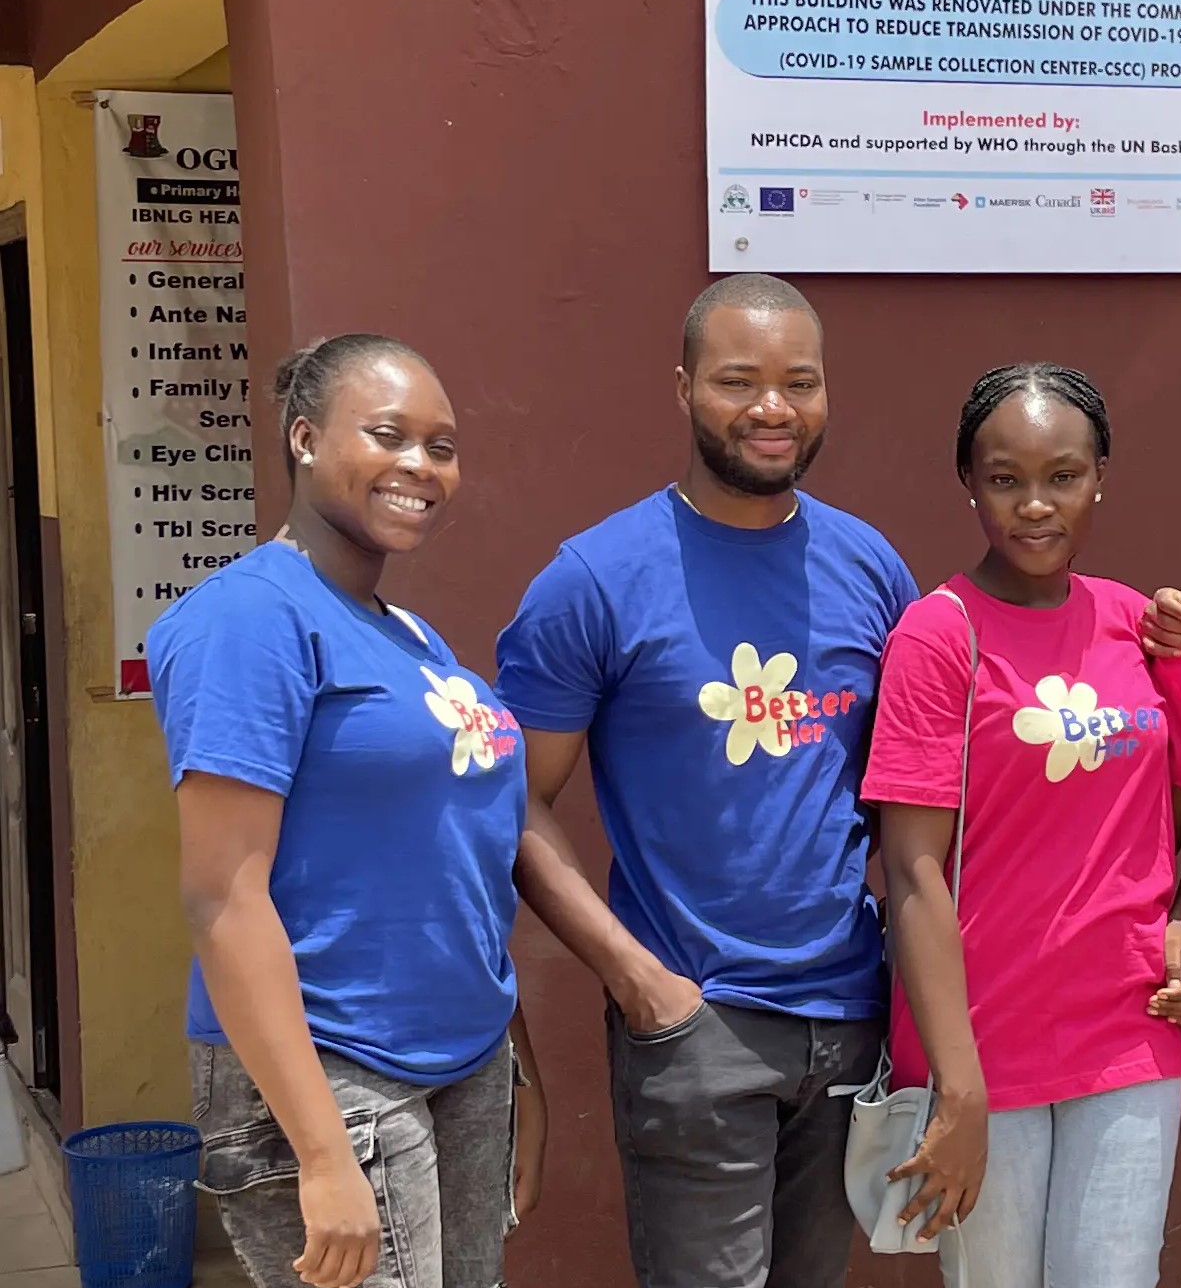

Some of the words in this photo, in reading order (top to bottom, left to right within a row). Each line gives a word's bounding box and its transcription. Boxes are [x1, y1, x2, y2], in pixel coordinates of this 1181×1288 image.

[1038, 0, 1096, 18] UNDER
[1102, 2, 1131, 19] THE
[743, 14, 840, 33] APPROACH
[847, 17, 869, 34] TO
[876, 19, 941, 37] REDUCE
[947, 21, 1074, 41] TRANSMISSION
[1080, 25, 1102, 42] OF
[779, 52, 866, 71] (COVID-19
[871, 55, 932, 72] SAMPLE
[938, 56, 1035, 75] COLLECTION
[1040, 60, 1146, 81] CENTER-CSCC)
[923, 110, 1046, 130] Implemented
[1053, 112, 1080, 132] by:
[751, 132, 823, 148] NPHCDA
[829, 134, 860, 149] and
[866, 136, 948, 153] supported
[954, 136, 972, 154] by
[977, 138, 1018, 152] WHO
[1024, 138, 1086, 155] through
[1091, 139, 1116, 154] the
[1121, 140, 1145, 154] UN
[160, 183, 221, 199] Primary
[226, 185, 240, 197] H
[1035, 194, 1081, 208] Canada
[132, 208, 192, 223] IBNLG
[200, 210, 240, 224] HEA
[128, 239, 162, 255] our
[169, 239, 242, 257] services
[147, 270, 245, 289] General
[149, 305, 207, 323] Ante
[216, 306, 247, 323] Na
[149, 342, 222, 360] Infant
[150, 379, 232, 401] Family
[151, 445, 196, 466] Eye
[205, 444, 252, 462] Clin
[152, 483, 193, 502] Hiv
[201, 483, 255, 501] Scre
[202, 520, 257, 537] Scre
[155, 582, 192, 602] Hy
[744, 685, 857, 723] Better
[1058, 704, 1160, 743] Better
[776, 719, 826, 749] Her
[1093, 737, 1139, 762] Her
